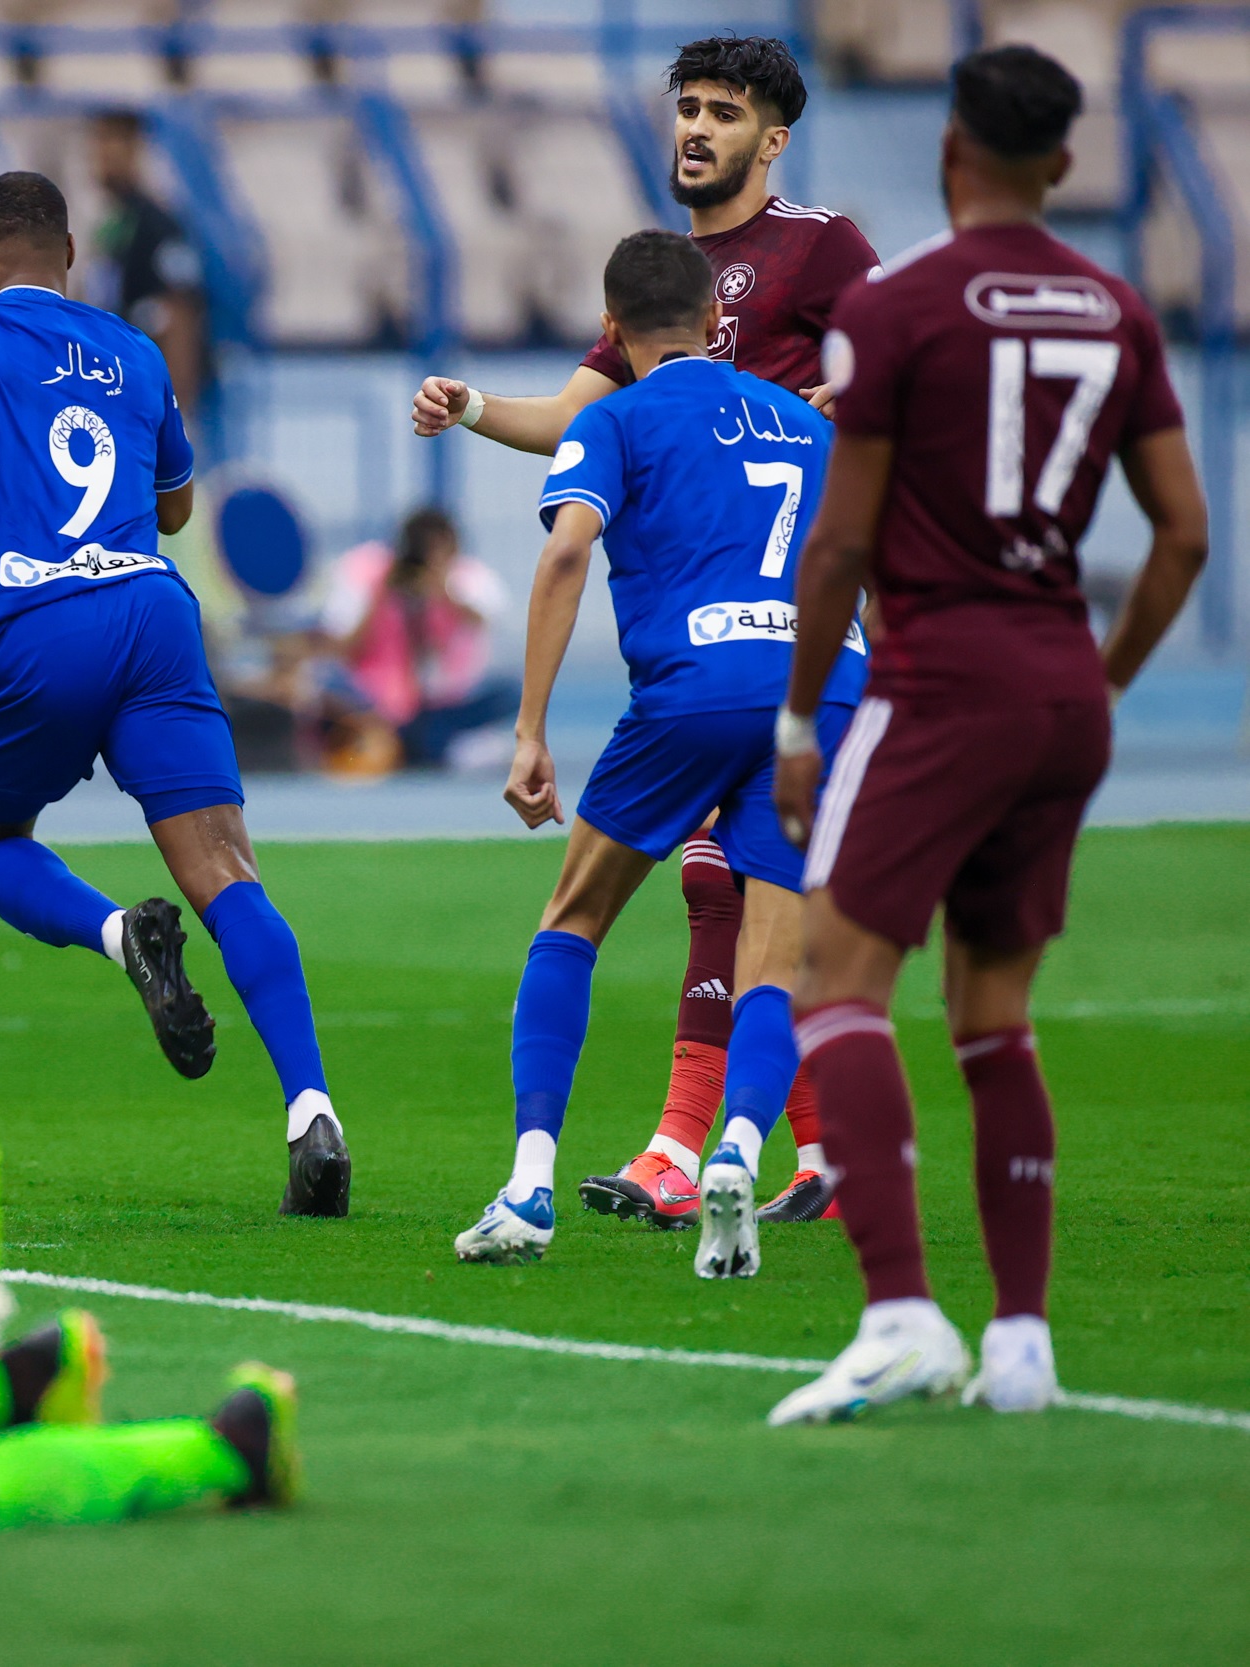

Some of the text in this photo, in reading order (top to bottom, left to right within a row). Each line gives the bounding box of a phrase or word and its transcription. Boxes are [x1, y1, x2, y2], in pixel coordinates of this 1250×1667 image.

[41, 341, 123, 396] إيغالو
[713, 397, 813, 445] سلمان
[986, 337, 1121, 518] 17
[48, 405, 116, 539] 9
[743, 461, 803, 579] 7
[44, 550, 160, 578] التعاونية
[686, 990, 734, 1002] adidas
